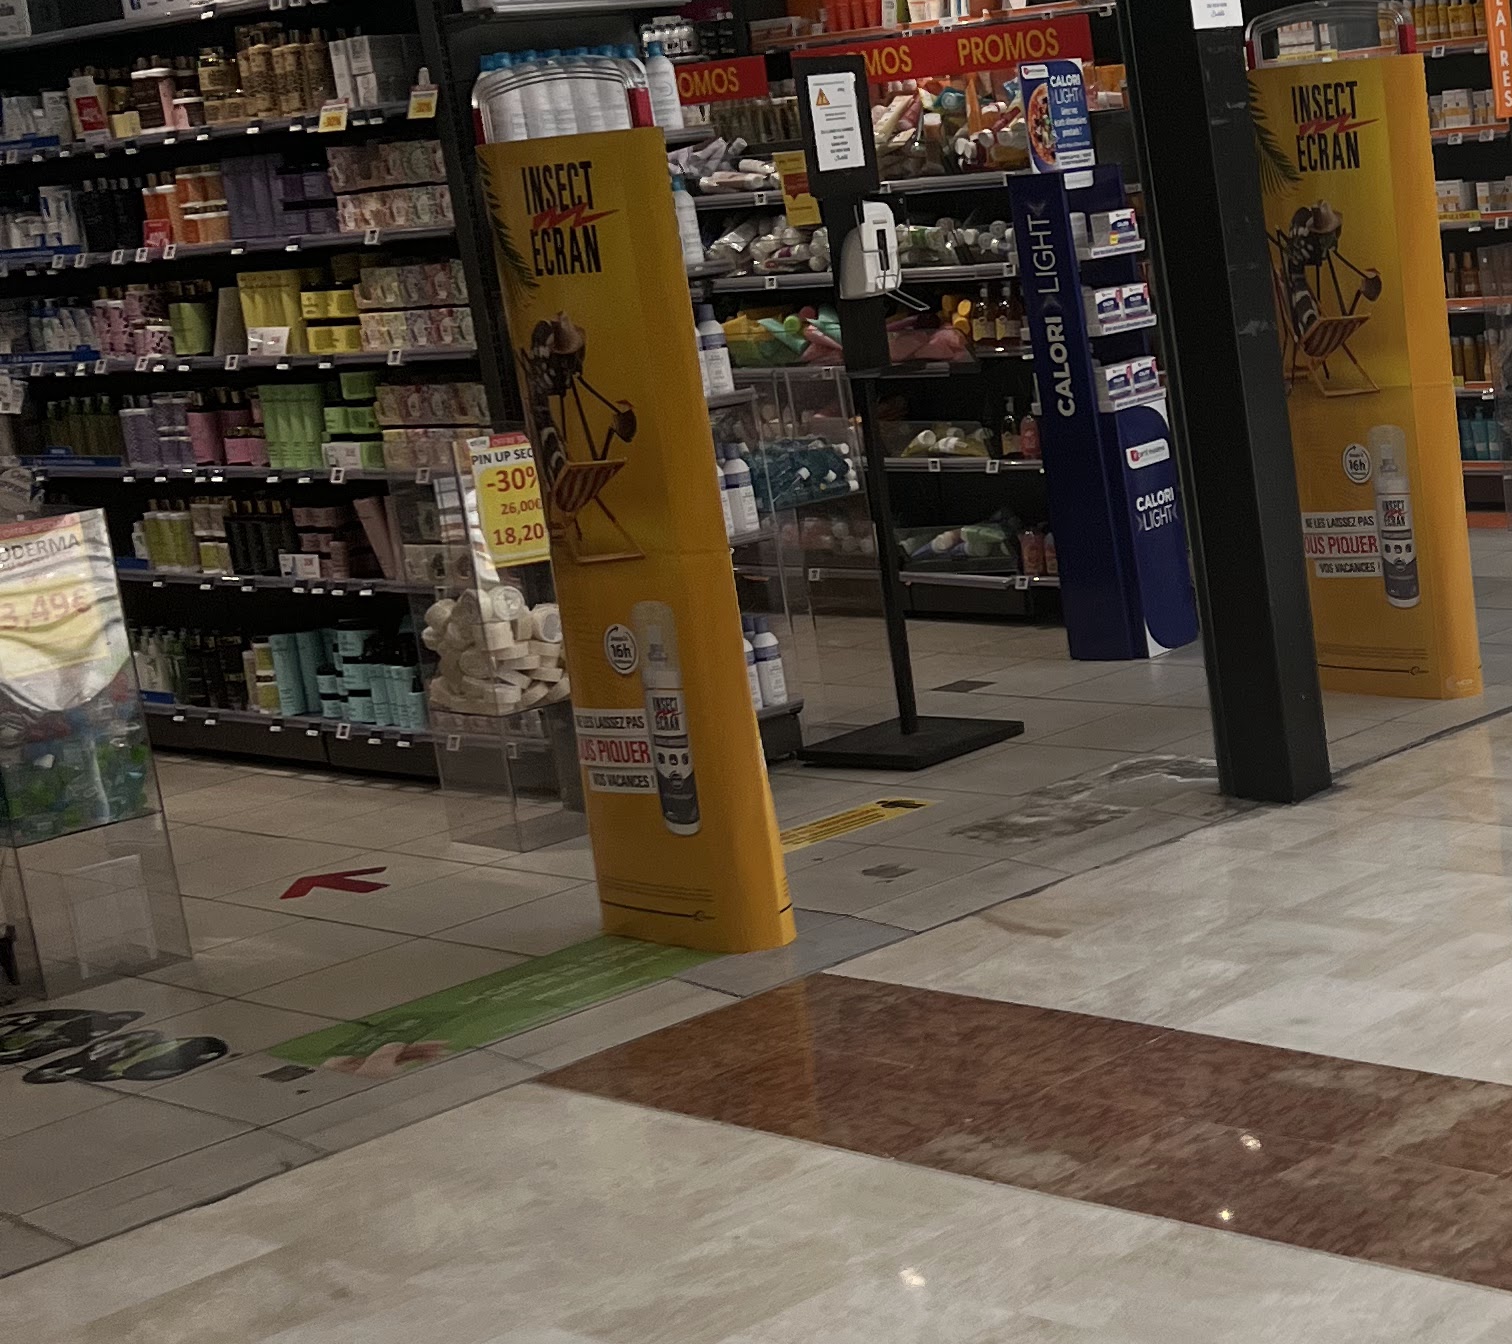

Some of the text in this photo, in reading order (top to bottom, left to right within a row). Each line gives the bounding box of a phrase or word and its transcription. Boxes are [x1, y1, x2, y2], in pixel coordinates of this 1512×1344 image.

[958, 27, 1061, 67] PROMOS
[1292, 81, 1358, 124] INSECT
[1296, 131, 1360, 172] ECRAN
[521, 160, 594, 215] INSECT
[530, 224, 602, 277] ECRAN
[1027, 214, 1076, 417] CALORI LIGHT
[472, 453, 492, 465] PIN
[495, 451, 511, 462] UP
[1136, 487, 1175, 512] CALORI
[1143, 505, 1173, 531] LIGHT
[1314, 518, 1326, 528] LES
[1327, 516, 1355, 527] LAISSEZ
[1358, 516, 1374, 526] PAS
[493, 523, 545, 546] 18,20
[1329, 535, 1378, 554] PIQUER
[1319, 562, 1333, 573] VOS
[1335, 561, 1375, 573] VACANCES
[625, 716, 645, 729] PAS
[598, 740, 651, 763] PIQUER
